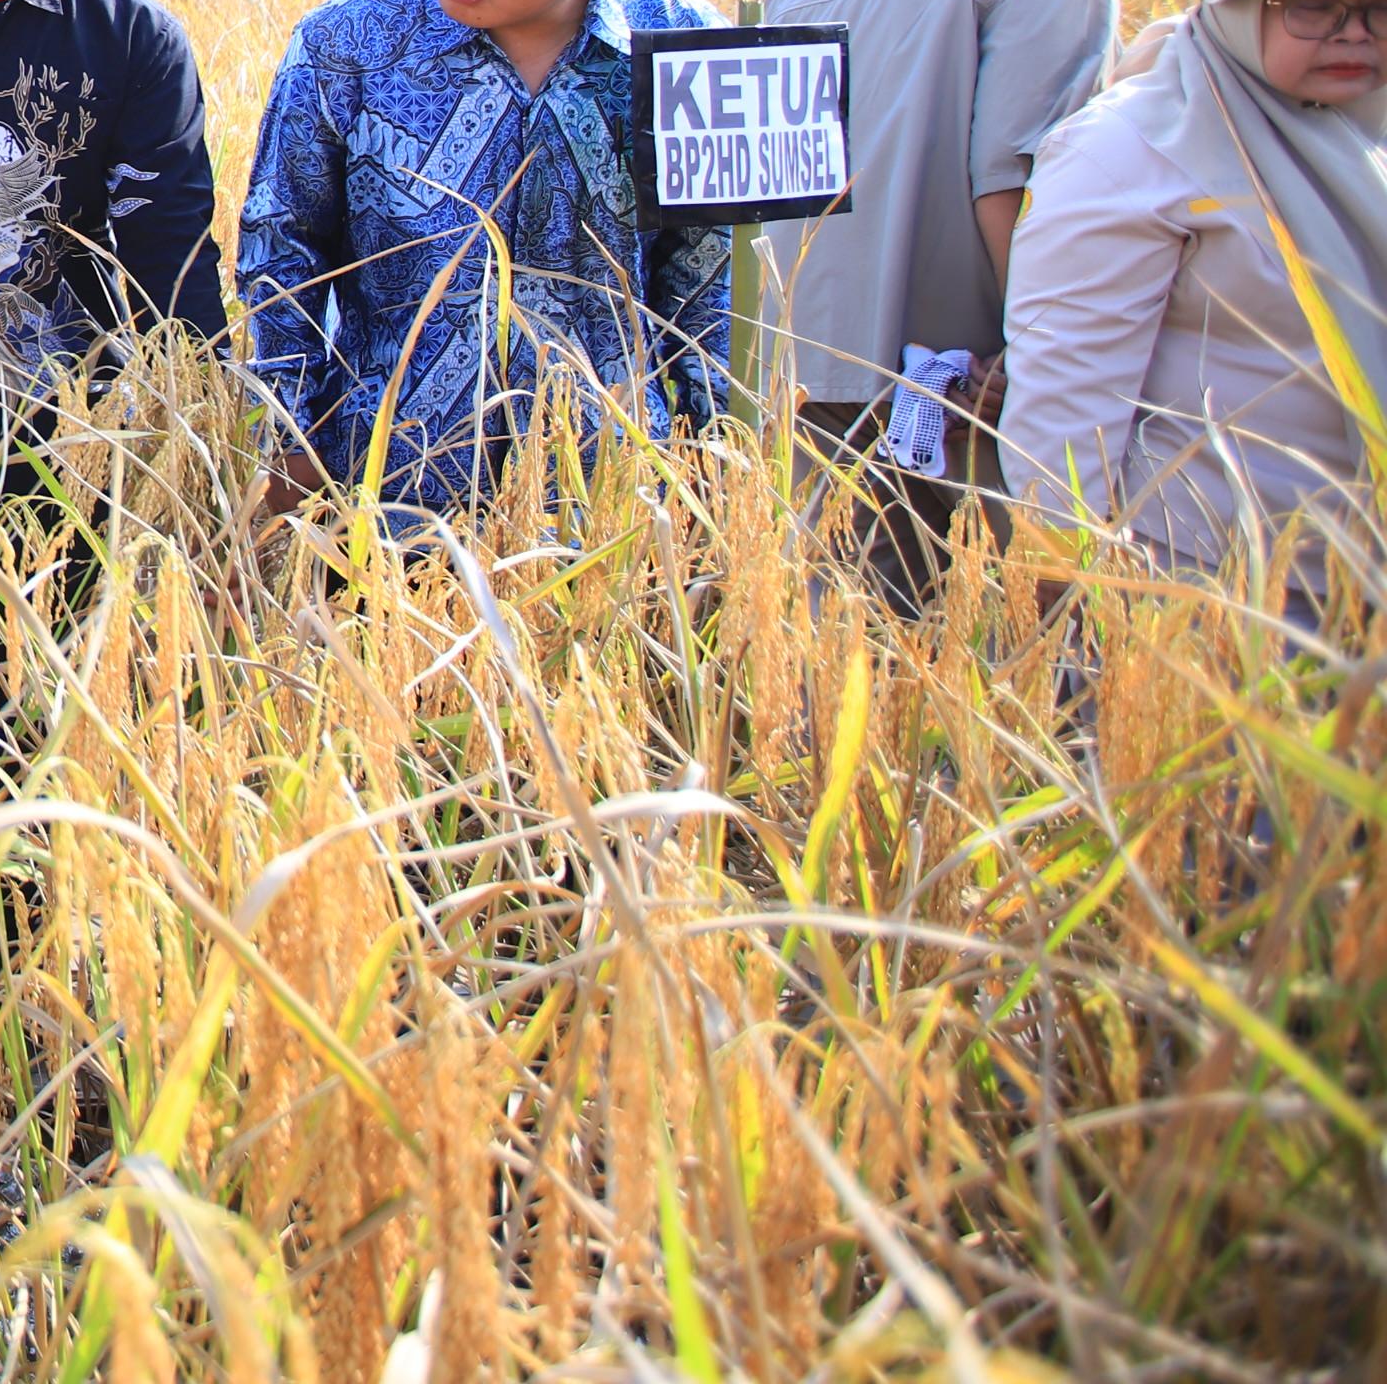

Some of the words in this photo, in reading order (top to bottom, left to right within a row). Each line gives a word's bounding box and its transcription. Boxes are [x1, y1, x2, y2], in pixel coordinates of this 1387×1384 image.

[659, 55, 840, 131] KETUA
[665, 134, 750, 200] BP2HD
[759, 129, 836, 196] SUMSEL
